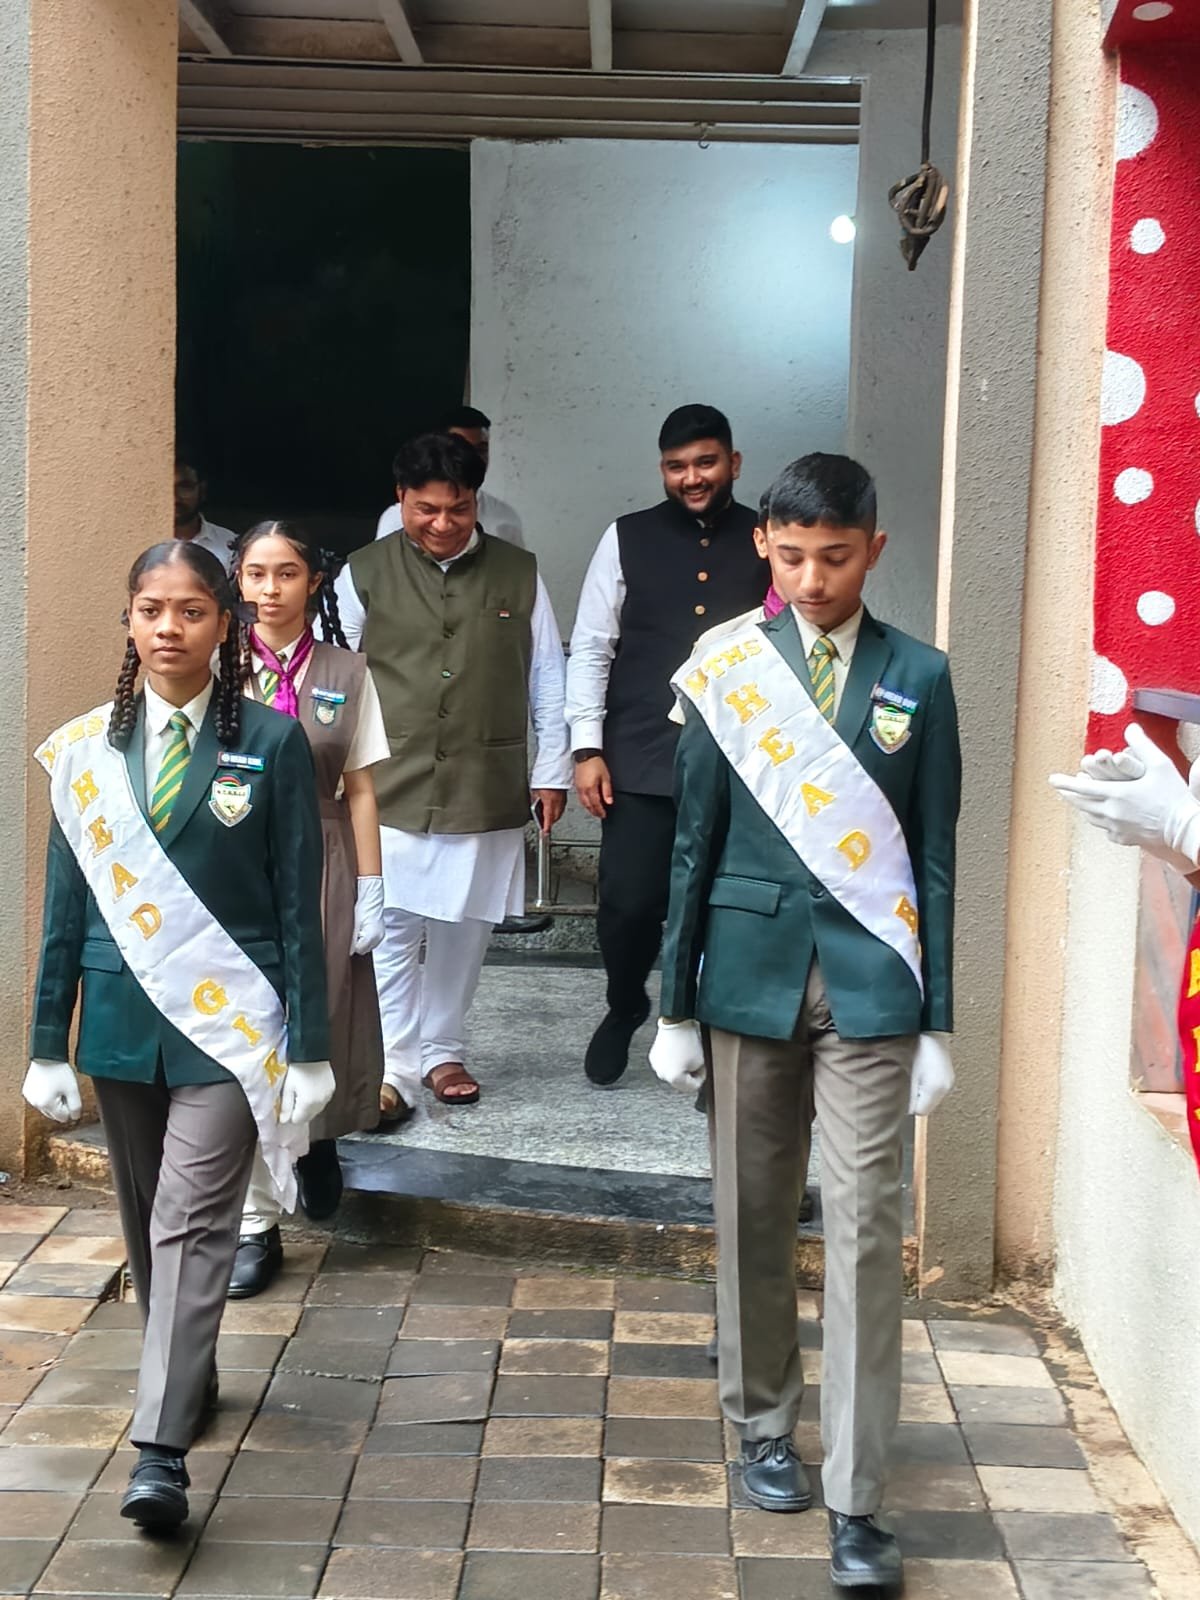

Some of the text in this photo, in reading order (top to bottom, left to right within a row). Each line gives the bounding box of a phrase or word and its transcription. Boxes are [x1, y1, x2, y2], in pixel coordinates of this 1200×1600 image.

[724, 681, 871, 872] HEAD
[71, 770, 163, 940] HEAD
[191, 977, 288, 1124] GIR
